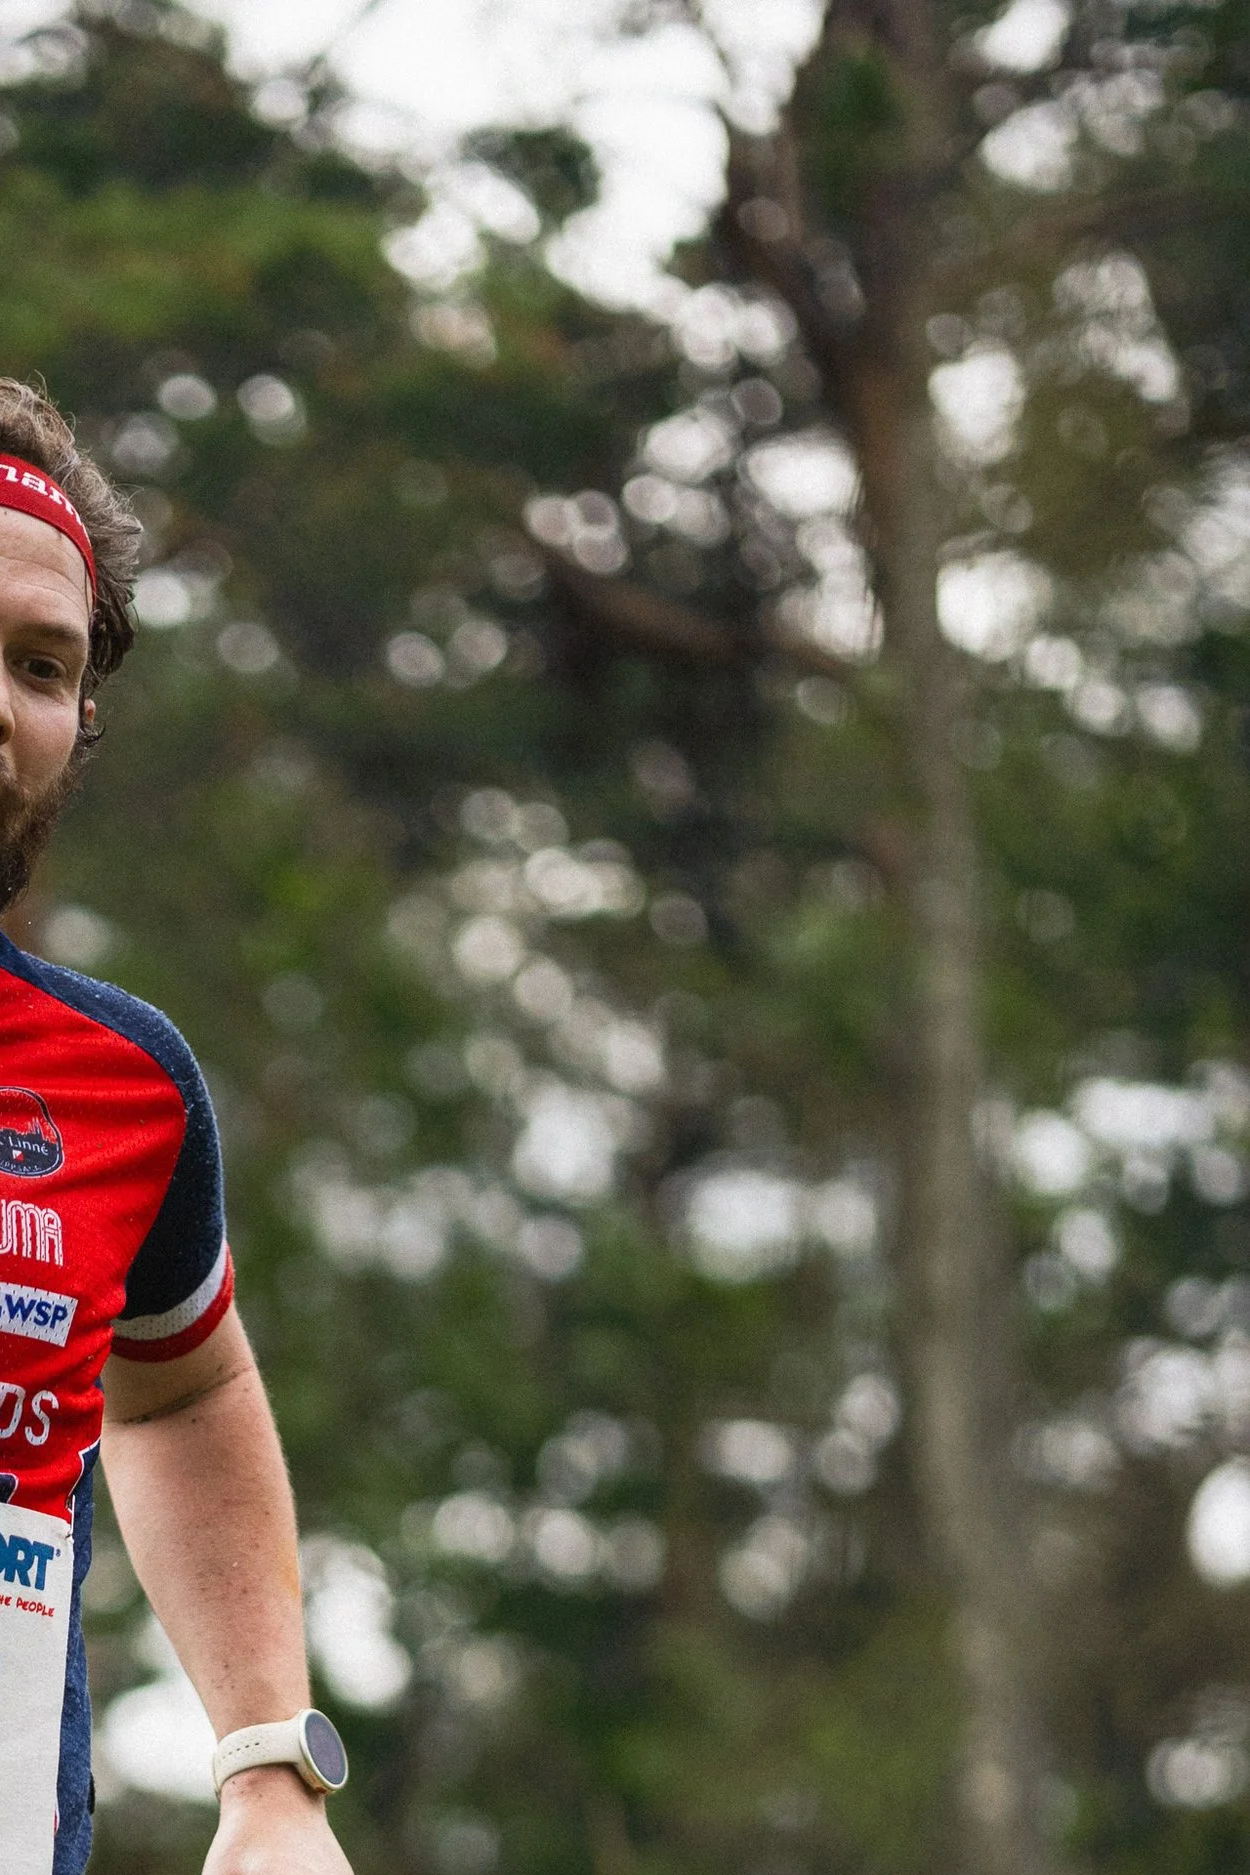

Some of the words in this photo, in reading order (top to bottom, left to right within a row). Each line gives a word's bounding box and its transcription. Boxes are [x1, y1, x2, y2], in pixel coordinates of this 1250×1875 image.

[9, 1136, 49, 1156] Linné
[5, 1294, 68, 1330] WSP
[16, 1597, 55, 1617] PEOPLE
